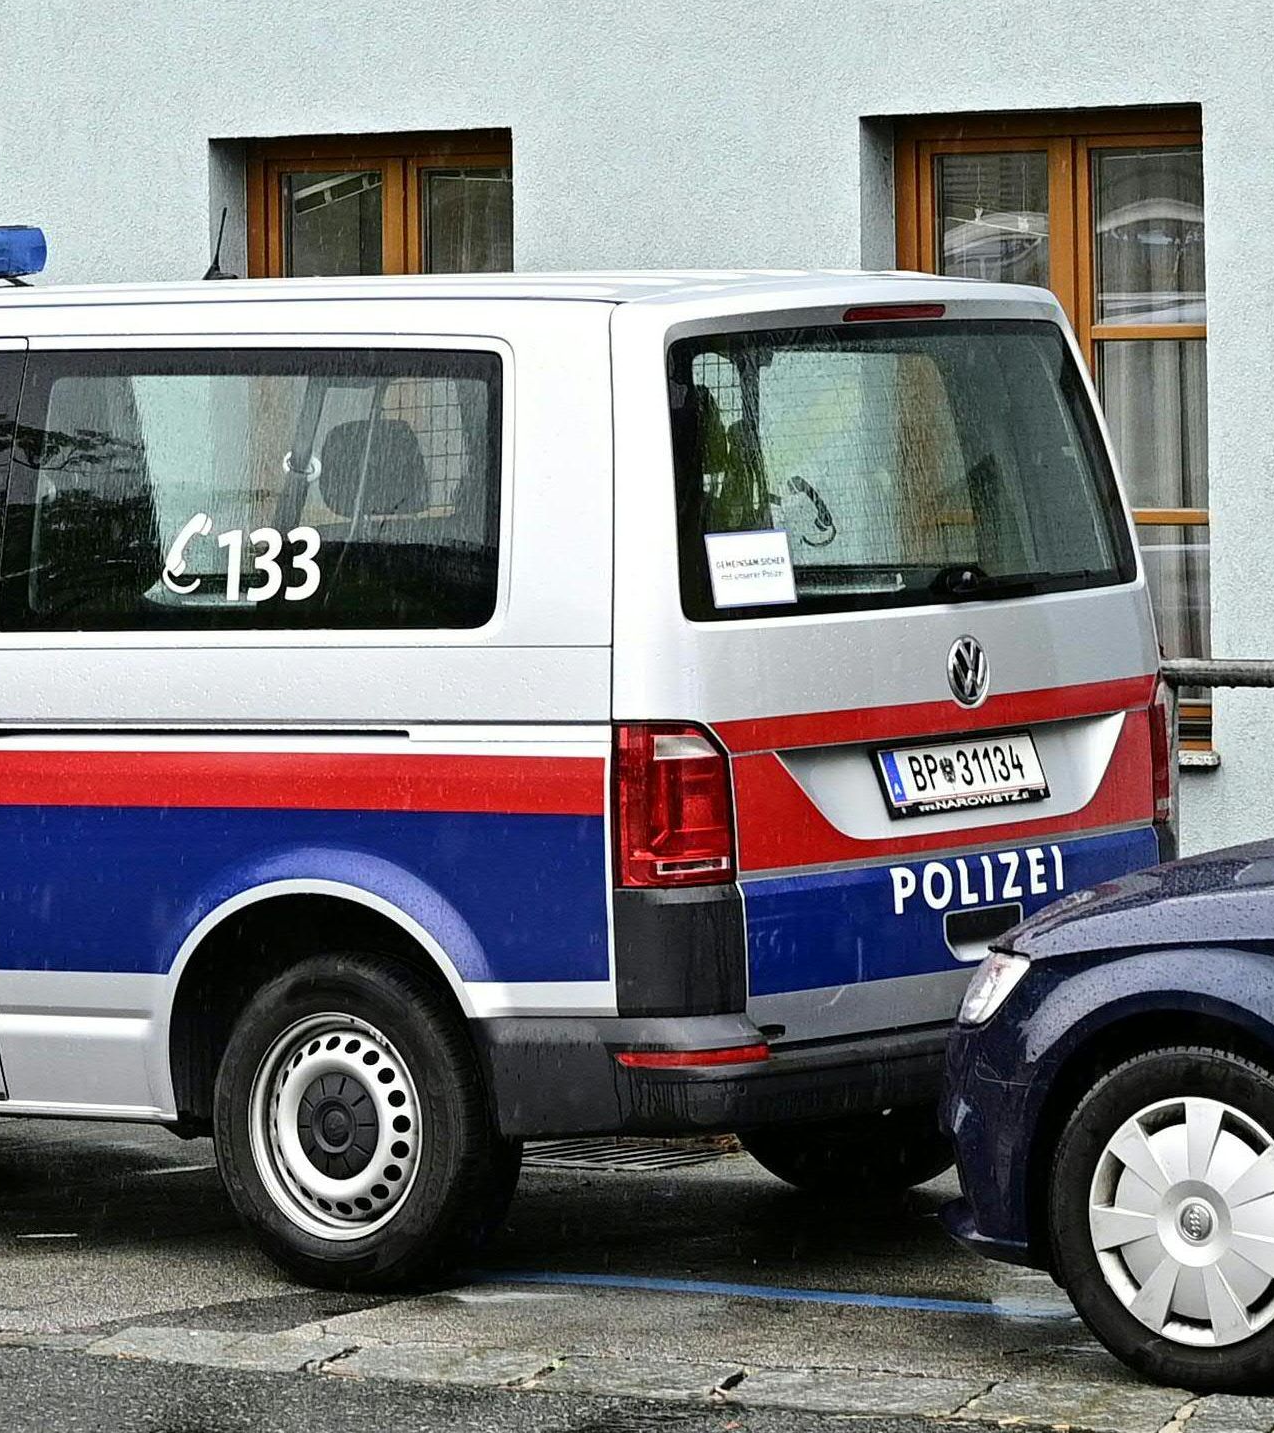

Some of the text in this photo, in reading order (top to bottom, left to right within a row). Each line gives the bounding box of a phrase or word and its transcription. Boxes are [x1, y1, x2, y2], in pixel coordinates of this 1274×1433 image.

[218, 526, 321, 603] 133
[956, 744, 1025, 786] 31134
[889, 845, 1064, 915] POLIZEI
